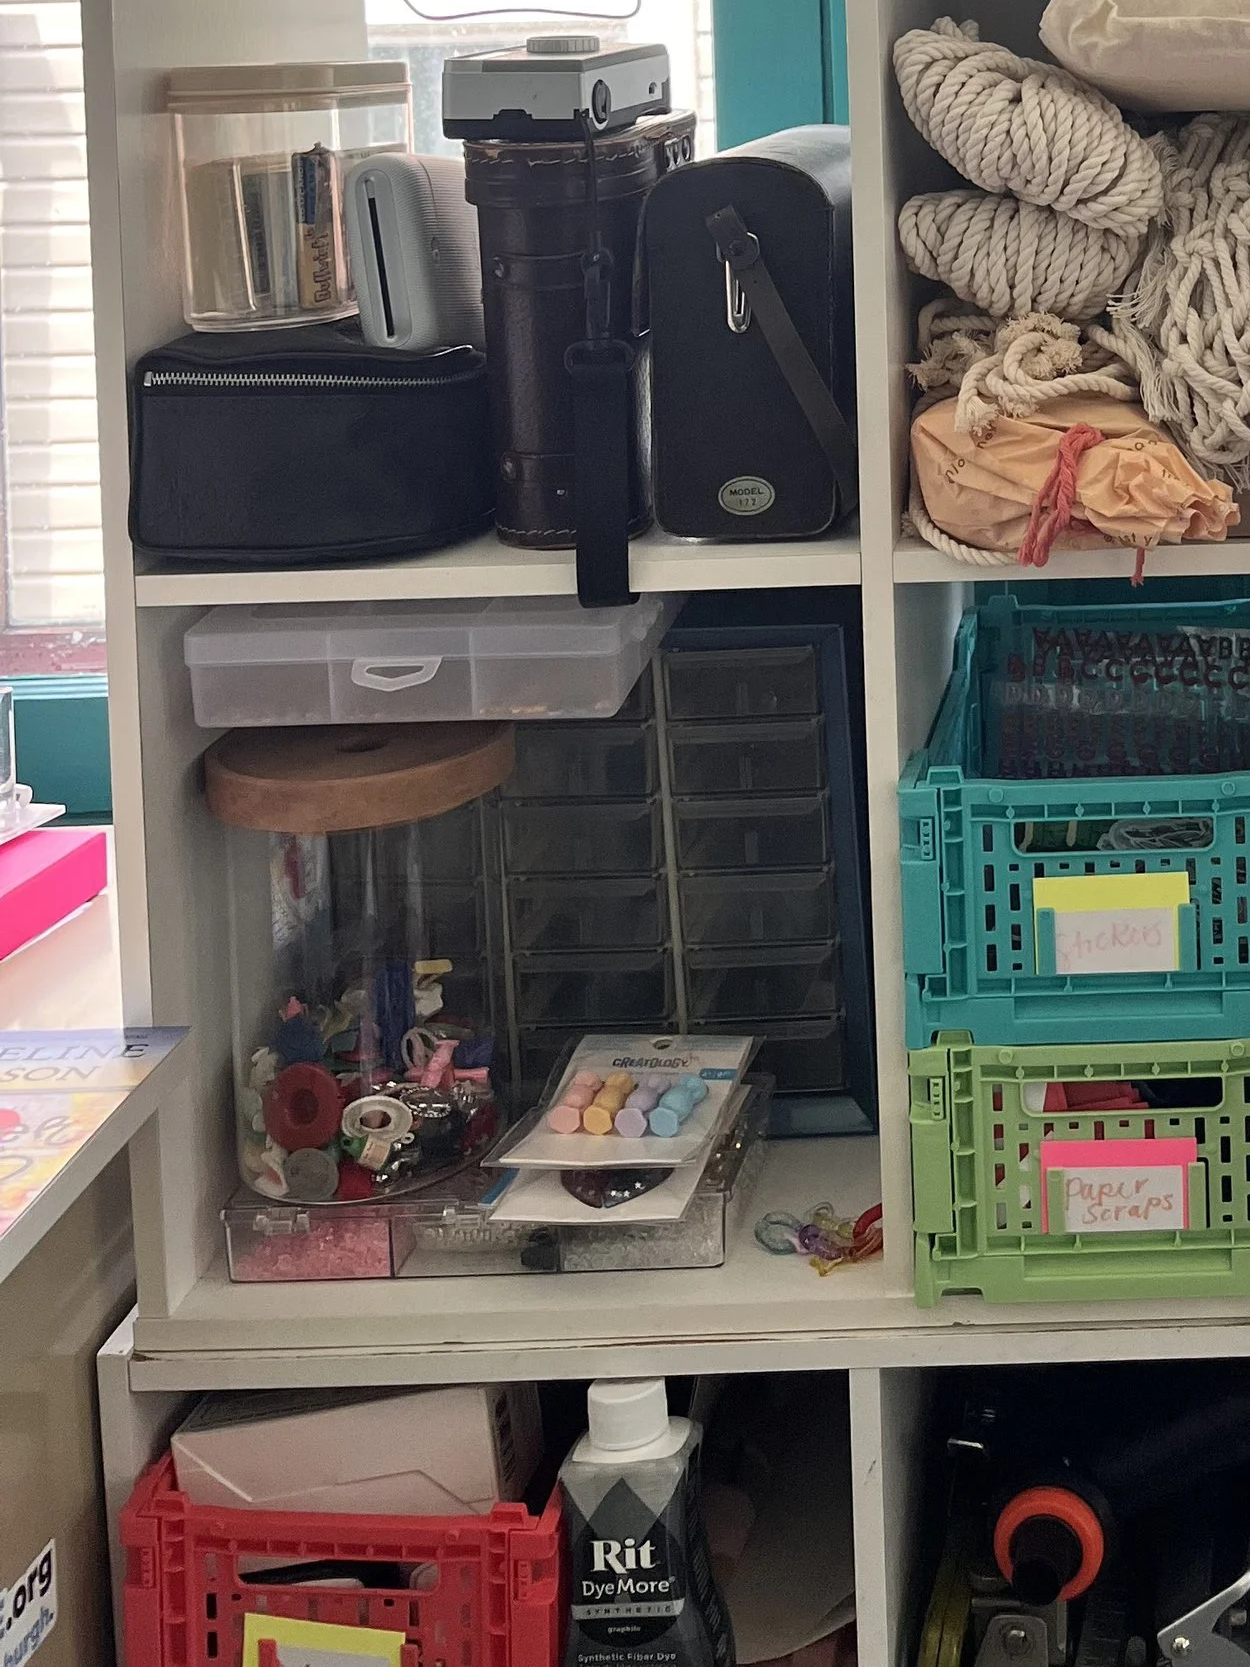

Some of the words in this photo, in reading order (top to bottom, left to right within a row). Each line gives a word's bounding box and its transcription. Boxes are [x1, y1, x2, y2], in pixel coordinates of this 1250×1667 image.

[729, 487, 765, 496] MODEL
[590, 1538, 660, 1574] Rit
[587, 1606, 671, 1616] SYNTHETIC
[578, 1653, 625, 1664] Synthetic
[627, 1652, 654, 1661] Fiber
[657, 1652, 677, 1662] Dye
